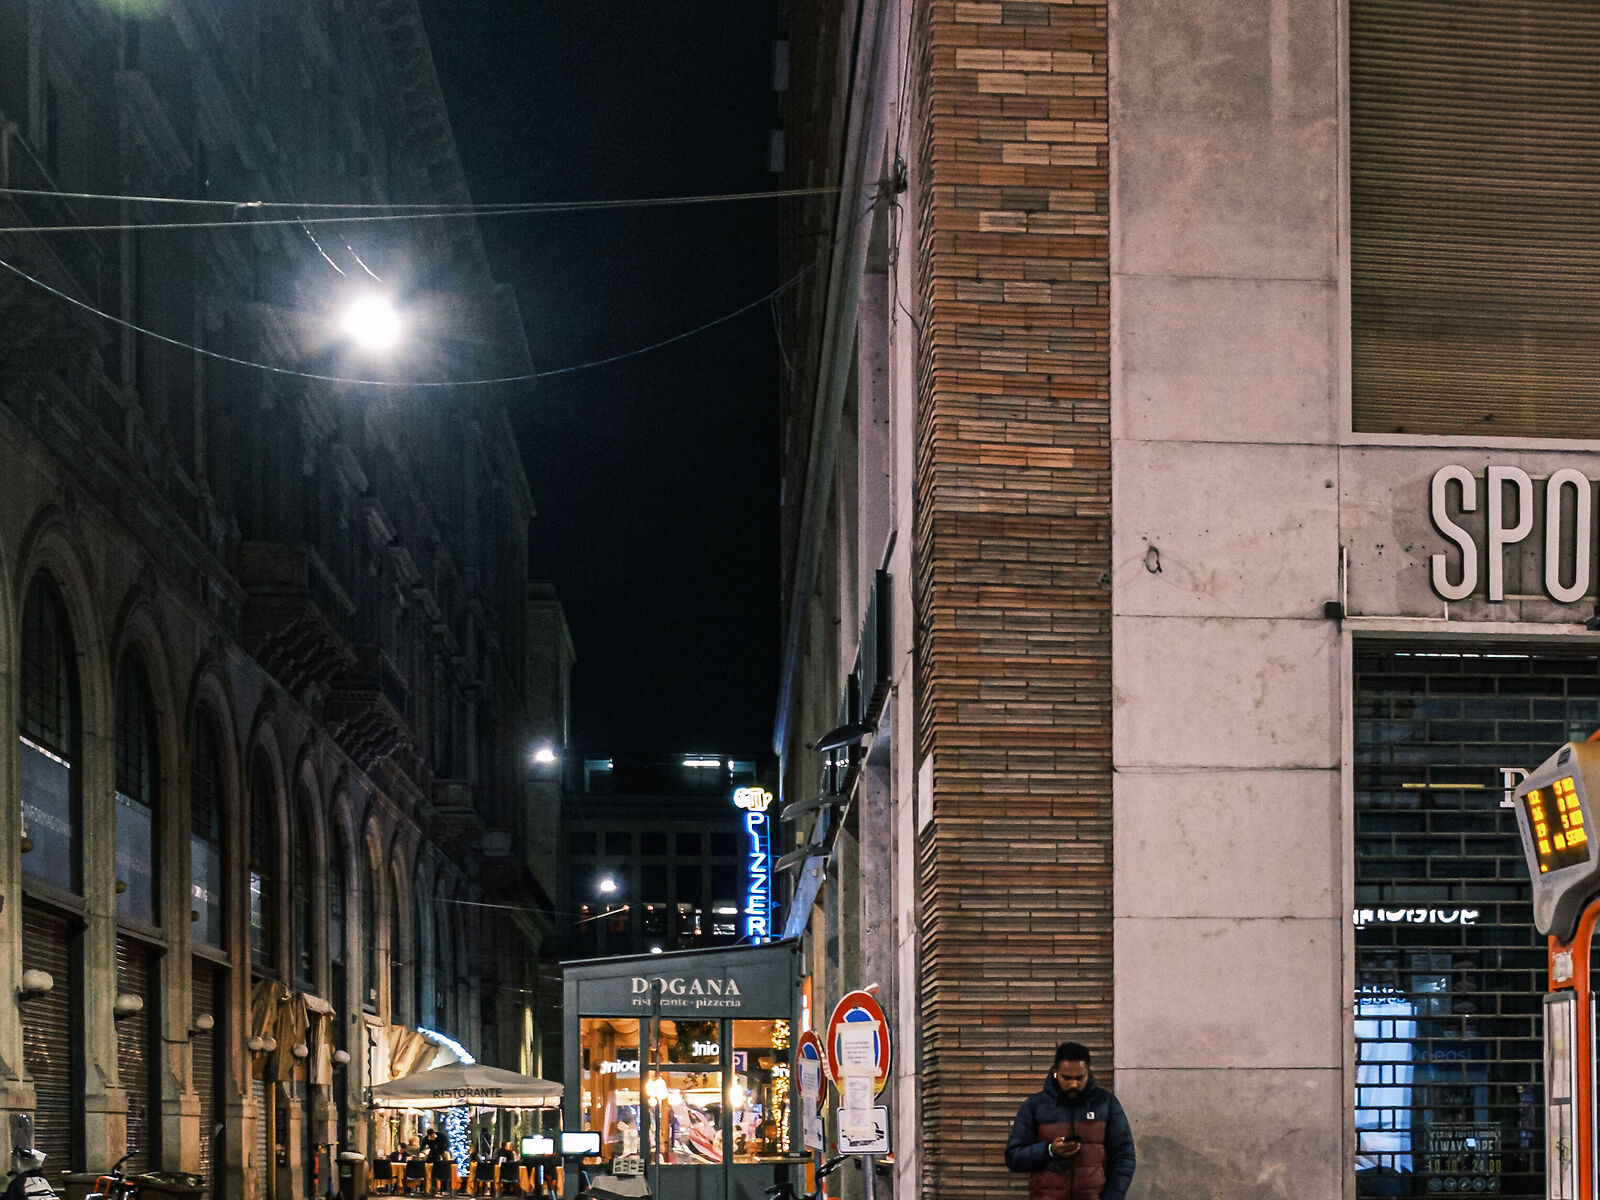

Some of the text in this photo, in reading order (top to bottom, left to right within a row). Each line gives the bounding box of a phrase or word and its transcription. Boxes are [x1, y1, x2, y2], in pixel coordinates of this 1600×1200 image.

[1431, 464, 1592, 603] SPO
[631, 977, 741, 996] DOGANA
[632, 997, 688, 1007] ristrante
[695, 997, 741, 1009] pizzeria
[433, 1087, 503, 1099] RISTORANTE
